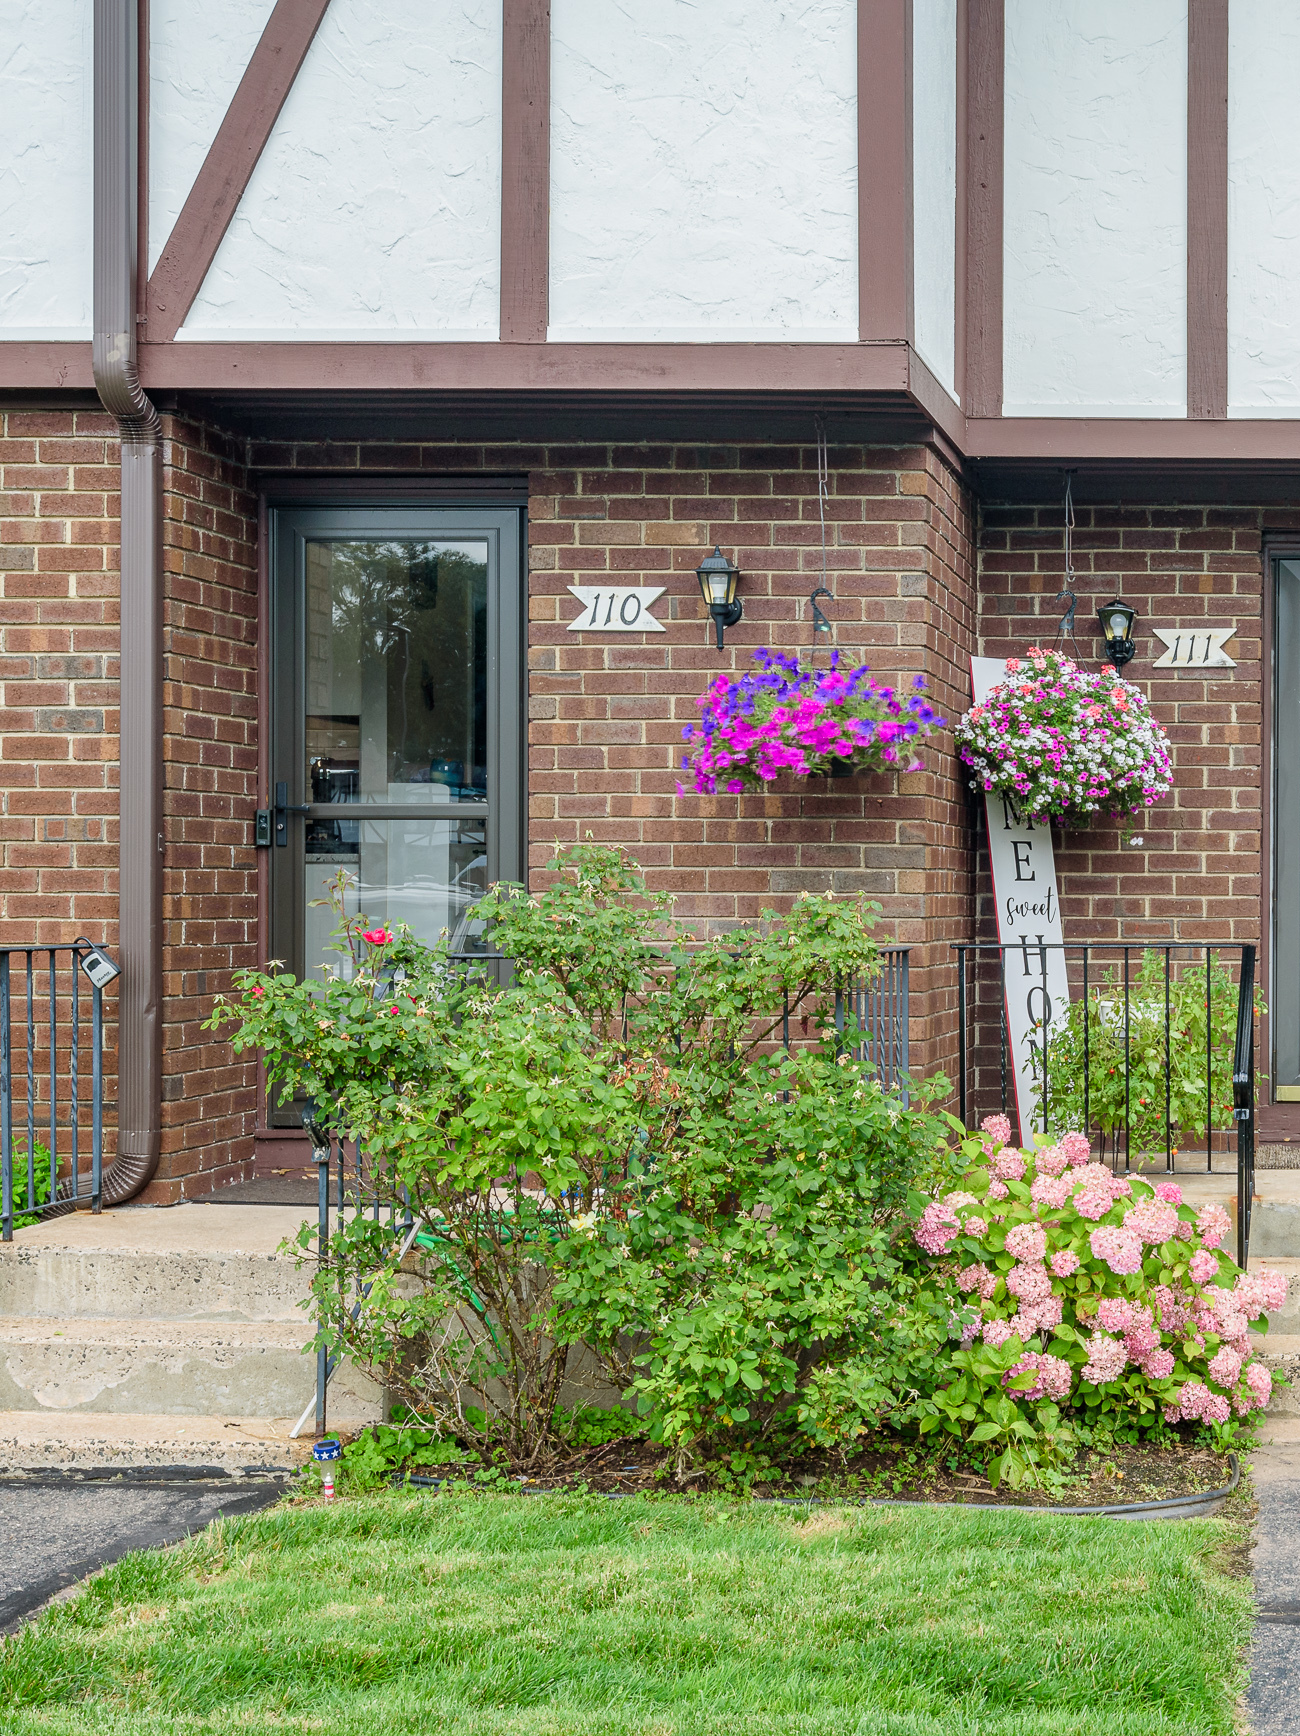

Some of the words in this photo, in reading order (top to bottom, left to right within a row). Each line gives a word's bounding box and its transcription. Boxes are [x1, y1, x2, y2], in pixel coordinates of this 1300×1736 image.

[588, 592, 642, 627] 110
[1170, 633, 1212, 665] 111
[1006, 886, 1057, 926] sweet
